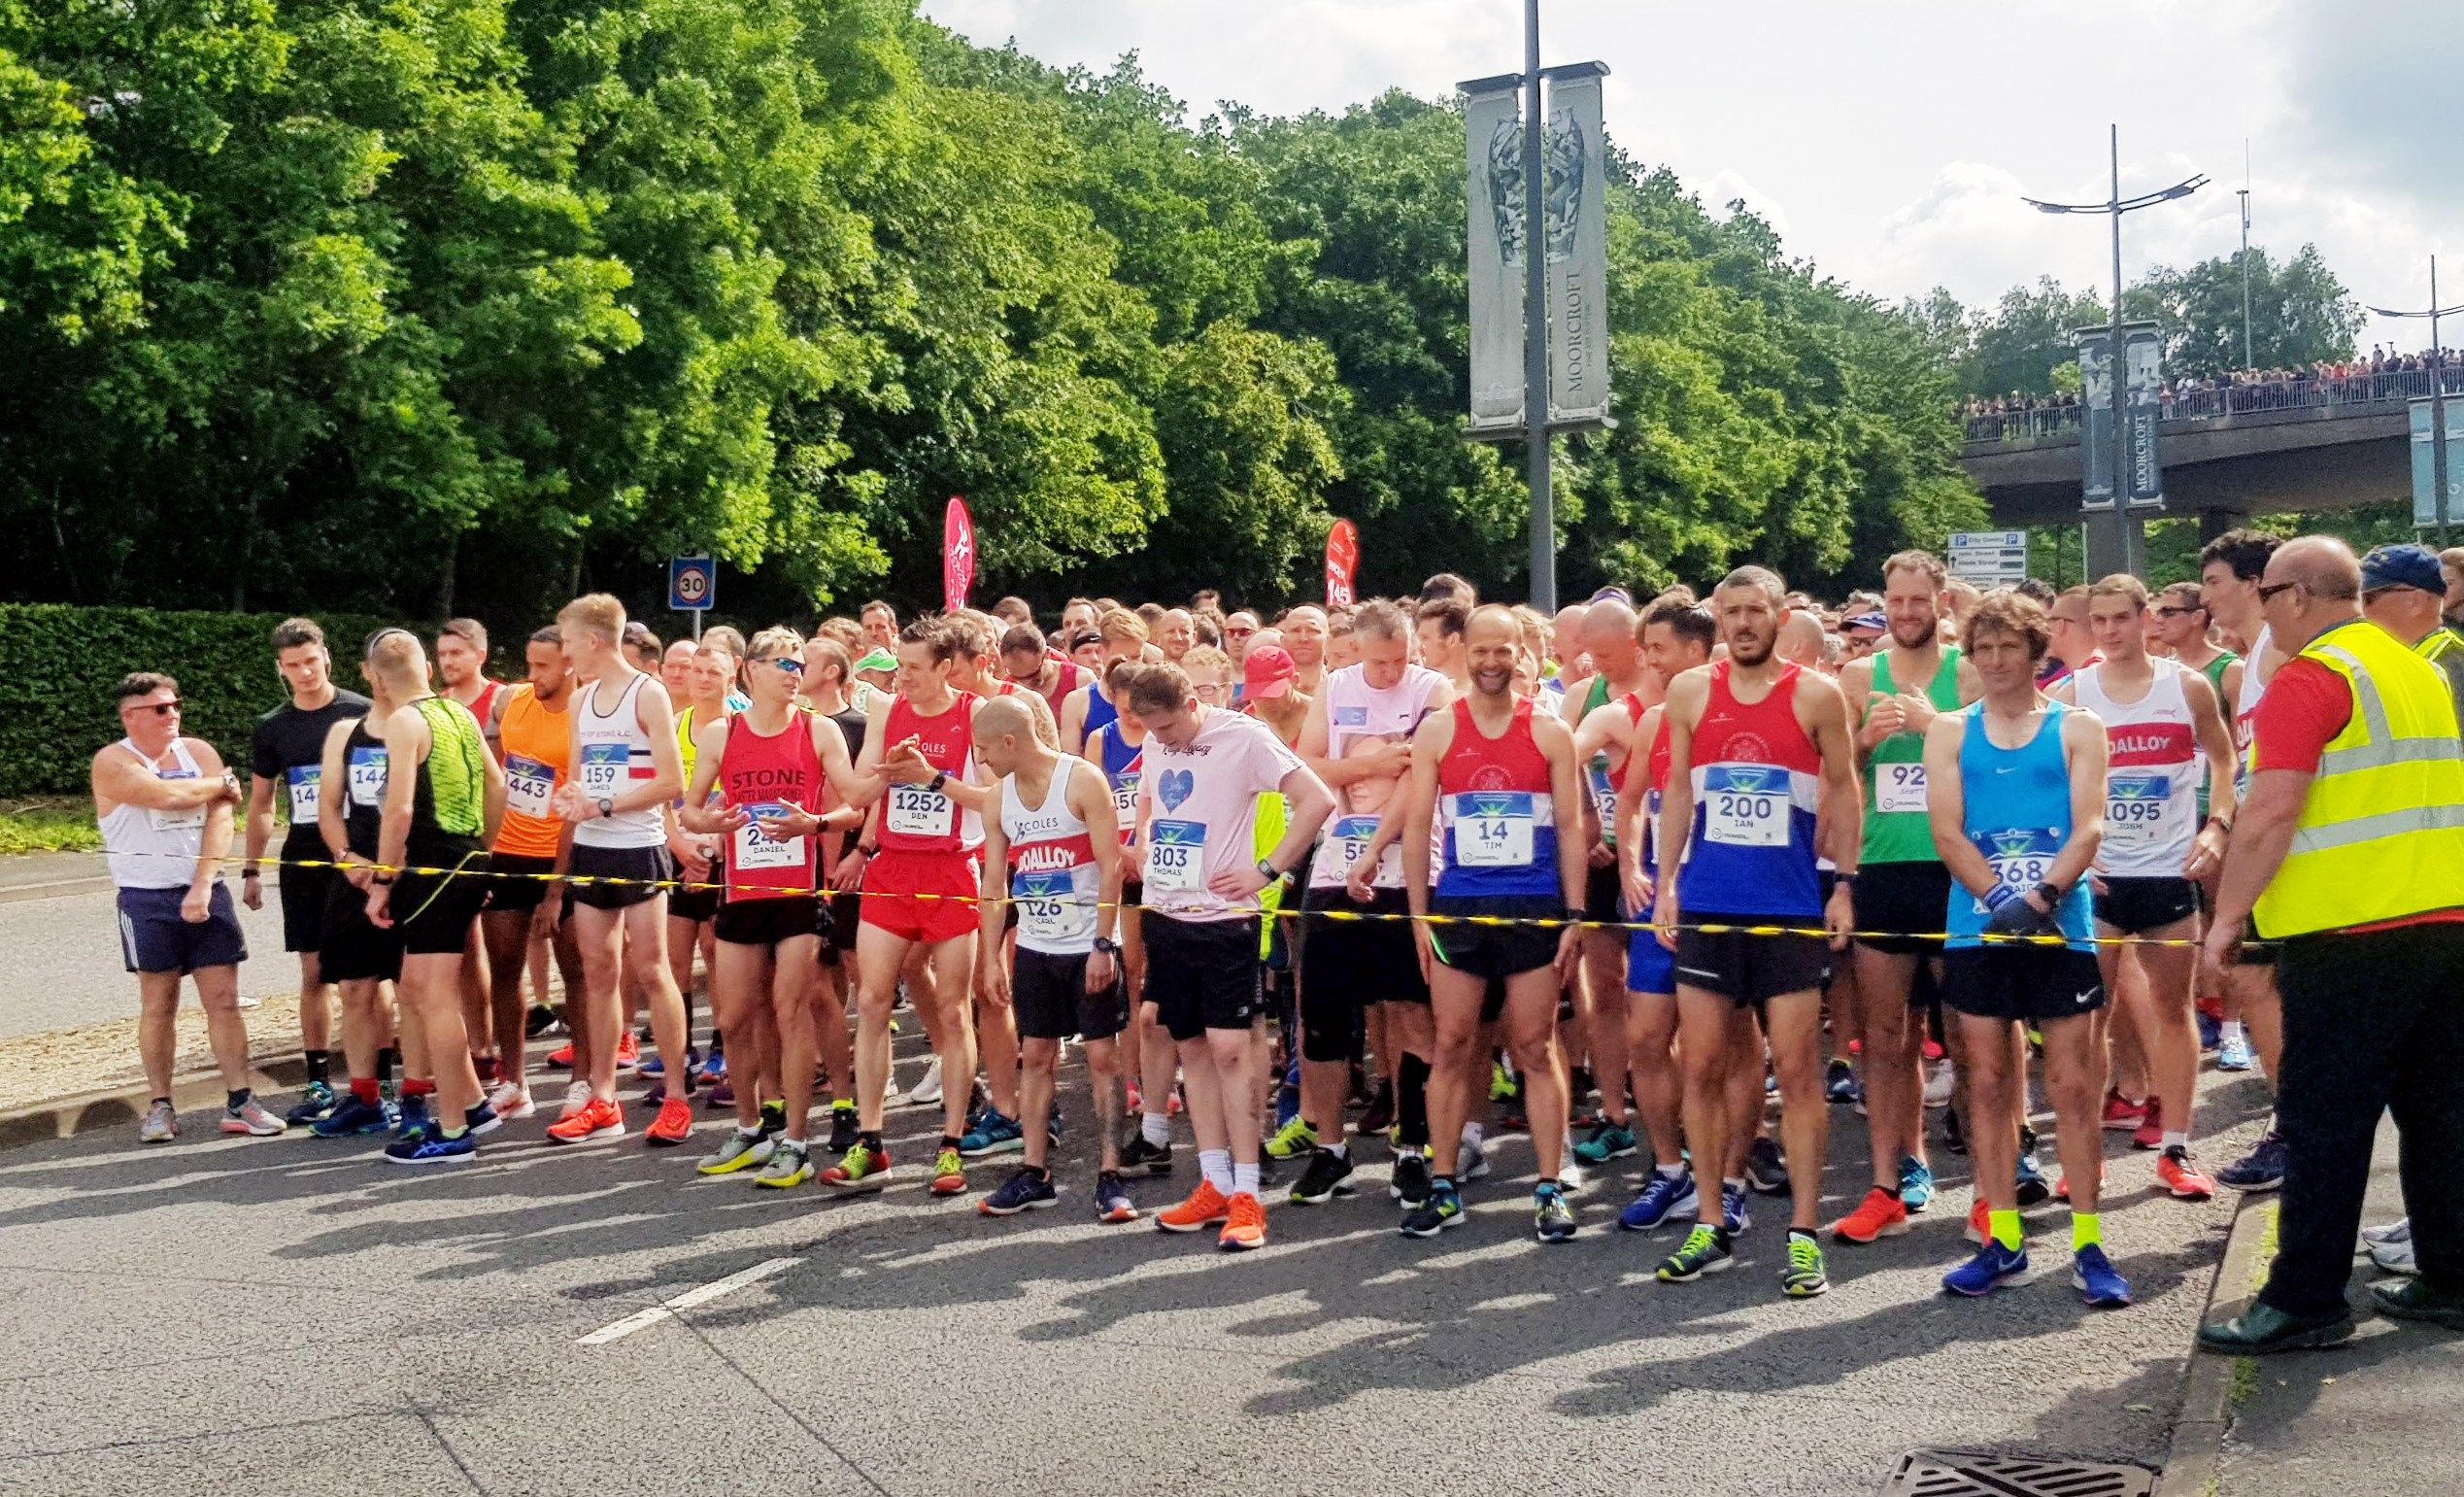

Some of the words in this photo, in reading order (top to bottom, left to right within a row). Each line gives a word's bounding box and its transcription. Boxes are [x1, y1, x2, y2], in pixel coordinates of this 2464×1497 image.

[1566, 272, 1583, 392] MOORCROFT
[2135, 415, 2147, 492] MOORCROFT
[682, 578, 703, 592] 30
[921, 742, 946, 754] OLES
[2108, 735, 2171, 755] OALLOY
[587, 766, 615, 783] 159
[732, 768, 805, 789] STONE
[895, 792, 946, 813] 1252
[1719, 796, 1772, 819] 200
[1024, 817, 1059, 832] COLES
[1478, 820, 1508, 840] 14
[1735, 819, 1754, 828] IAN
[1152, 846, 1187, 868] 803
[1989, 860, 2042, 883] 368
[1026, 898, 1062, 917] 126
